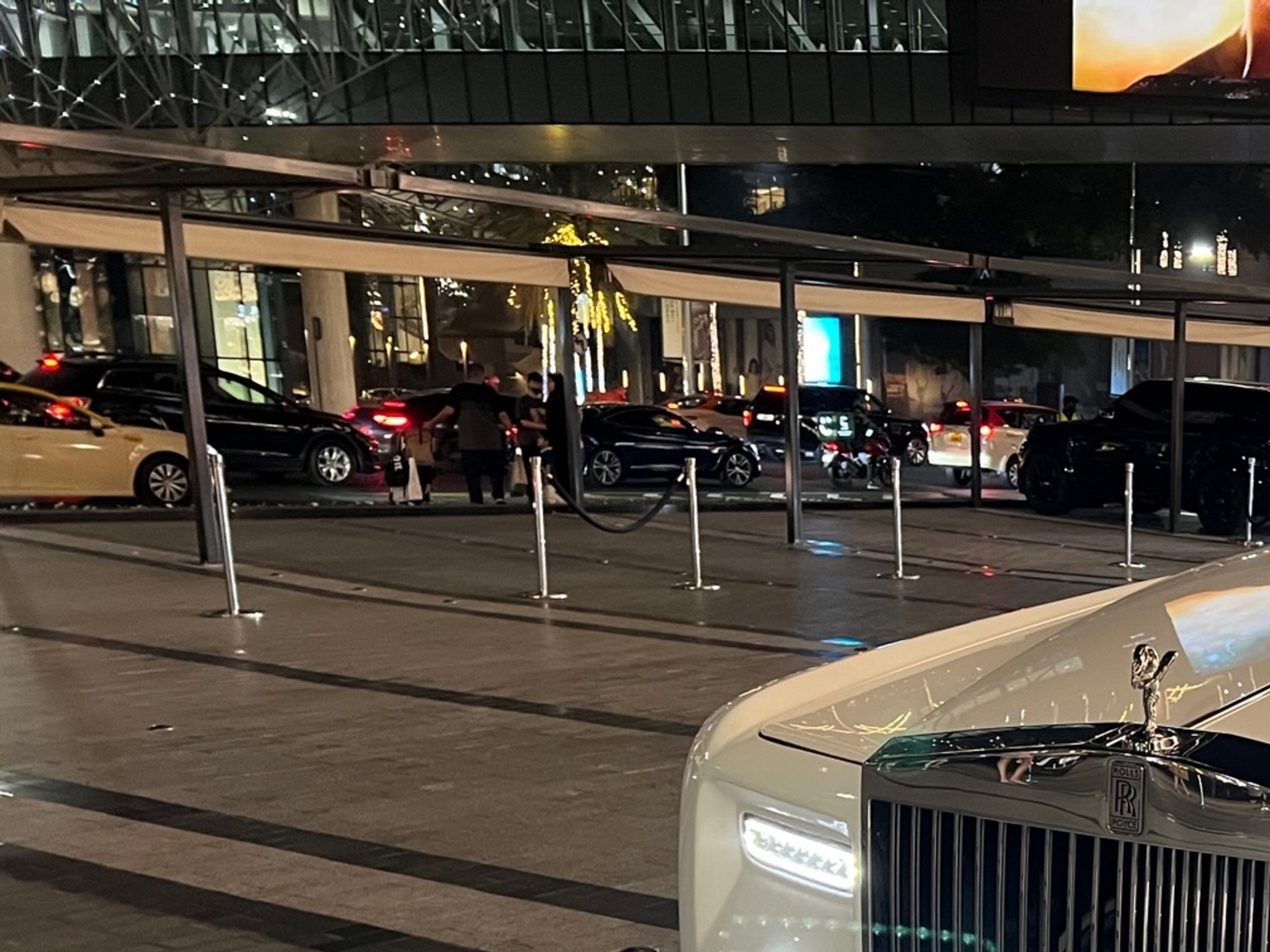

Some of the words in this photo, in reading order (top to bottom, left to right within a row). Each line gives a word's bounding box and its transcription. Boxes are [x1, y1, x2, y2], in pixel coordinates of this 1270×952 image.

[1113, 767, 1139, 778] ROLLS
[1114, 780, 1137, 817] RR
[1112, 818, 1137, 829] ROYCE
